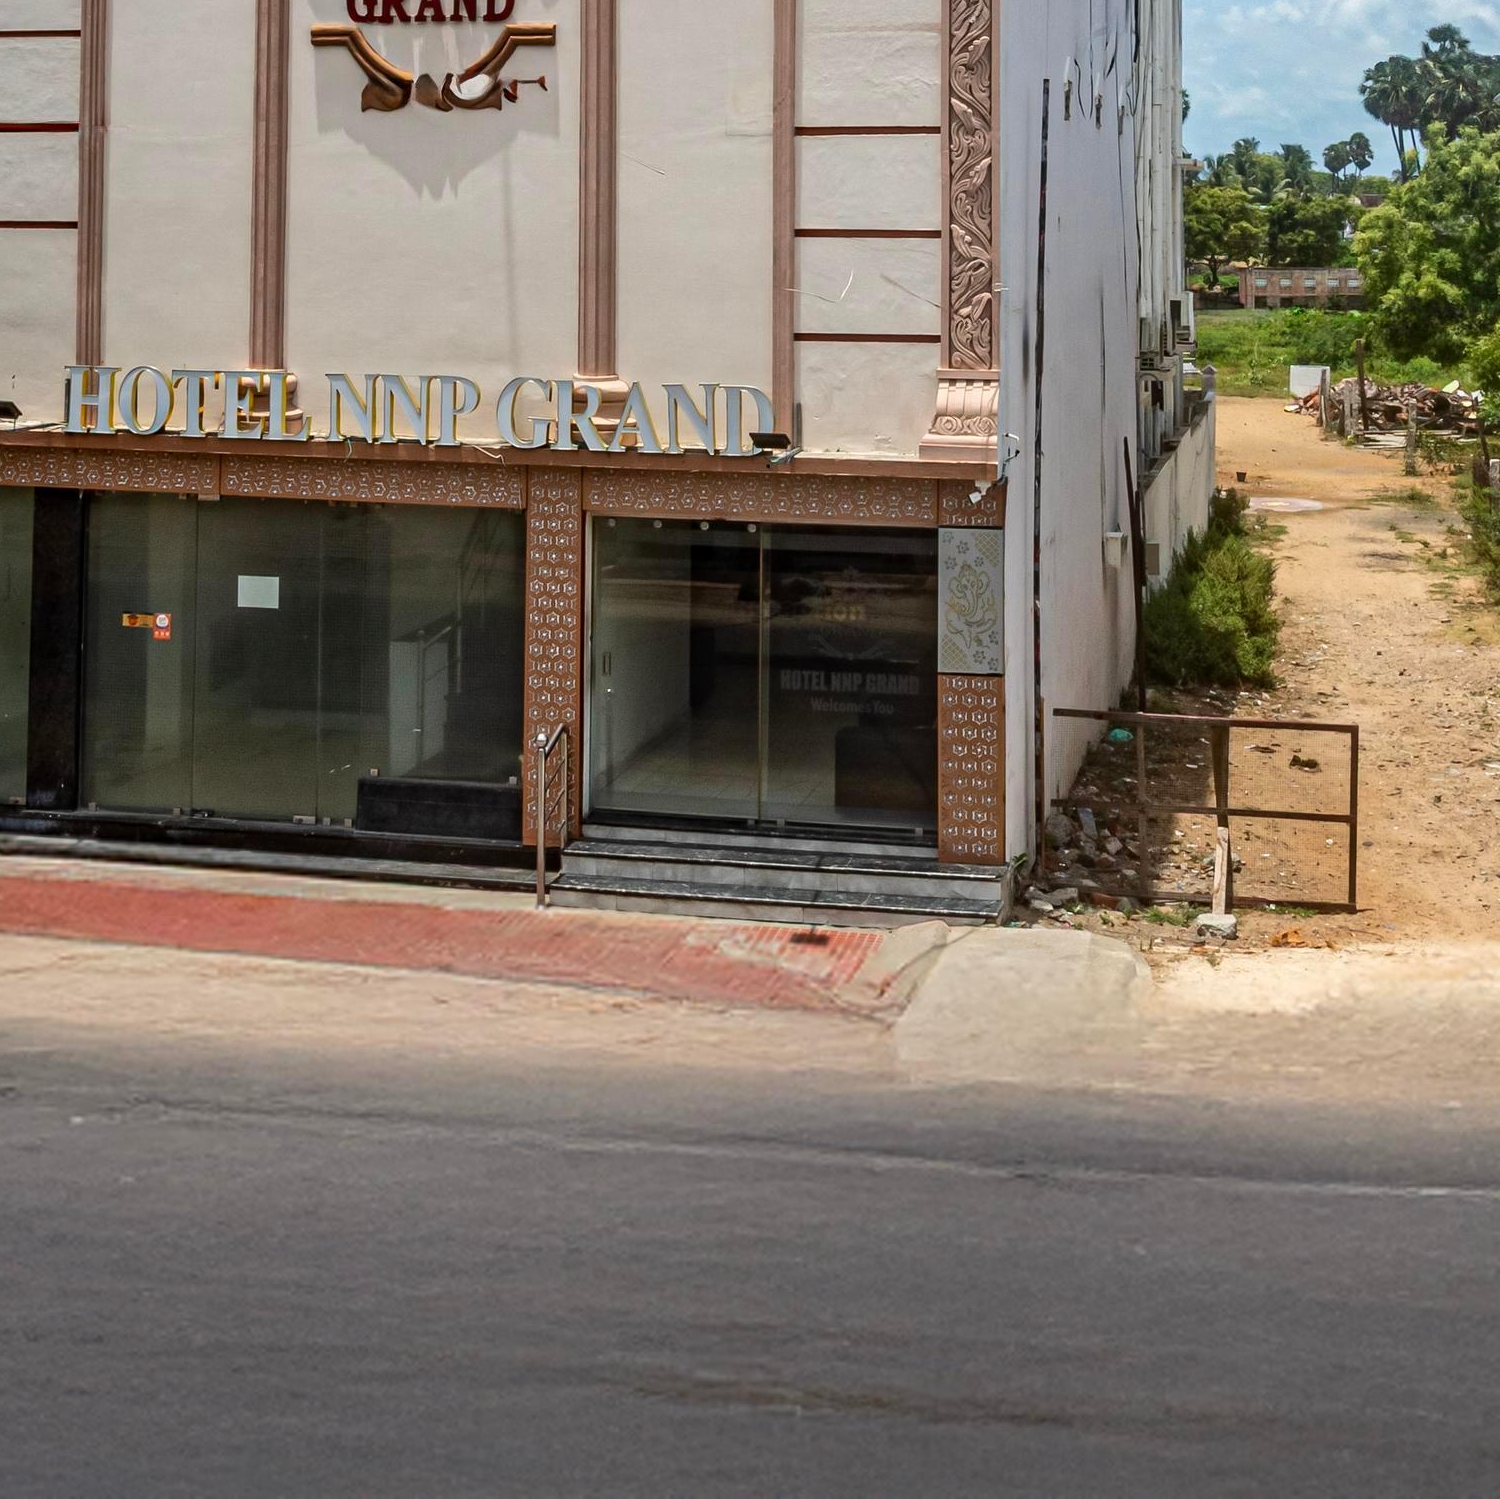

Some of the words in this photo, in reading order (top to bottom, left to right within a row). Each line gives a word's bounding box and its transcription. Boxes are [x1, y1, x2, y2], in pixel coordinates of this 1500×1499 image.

[64, 365, 311, 442] HOTEL
[325, 372, 481, 446] NNP
[496, 376, 775, 457] GRAND
[780, 669, 828, 691] HOTEL
[865, 674, 921, 695] GRAND
